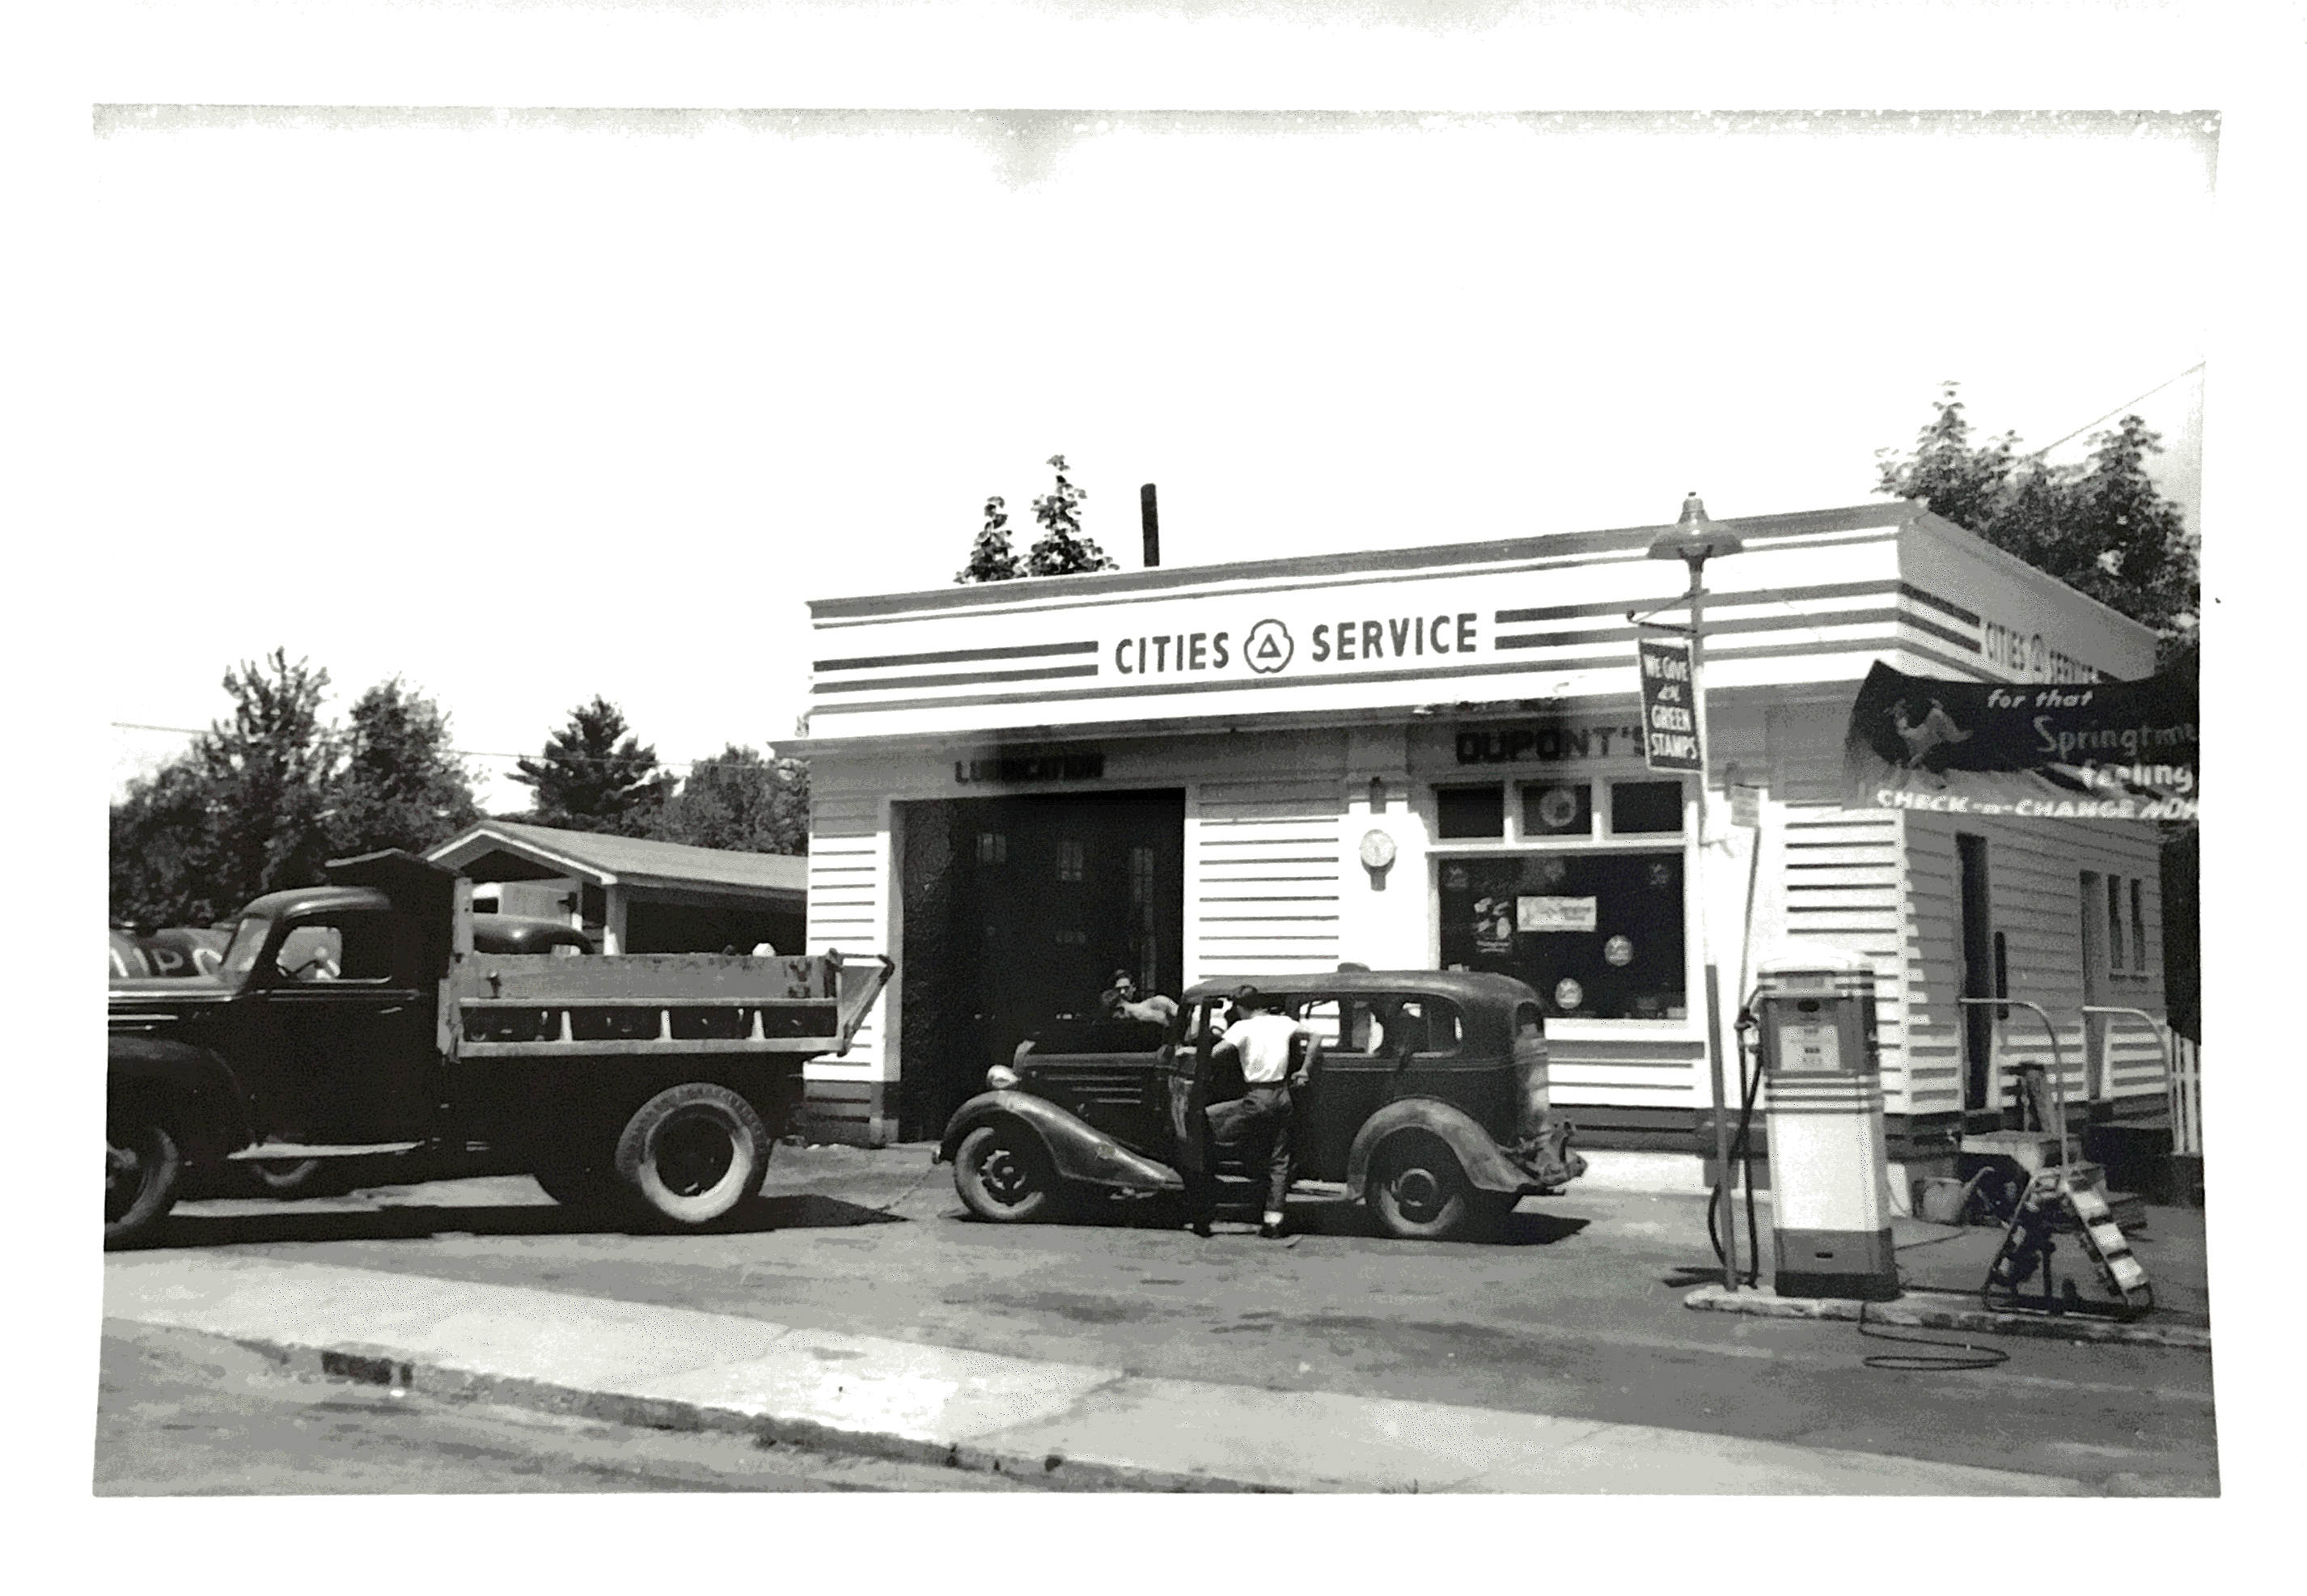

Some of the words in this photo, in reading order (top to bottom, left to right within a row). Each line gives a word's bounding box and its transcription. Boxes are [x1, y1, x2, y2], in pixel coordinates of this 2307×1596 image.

[1115, 632, 1229, 674] CITIES
[1312, 612, 1477, 662] SERVICE
[1987, 688, 2026, 709] for
[2035, 689, 2093, 708] that
[1652, 705, 1691, 731] GREEN
[1652, 732, 1697, 760] STAMPS
